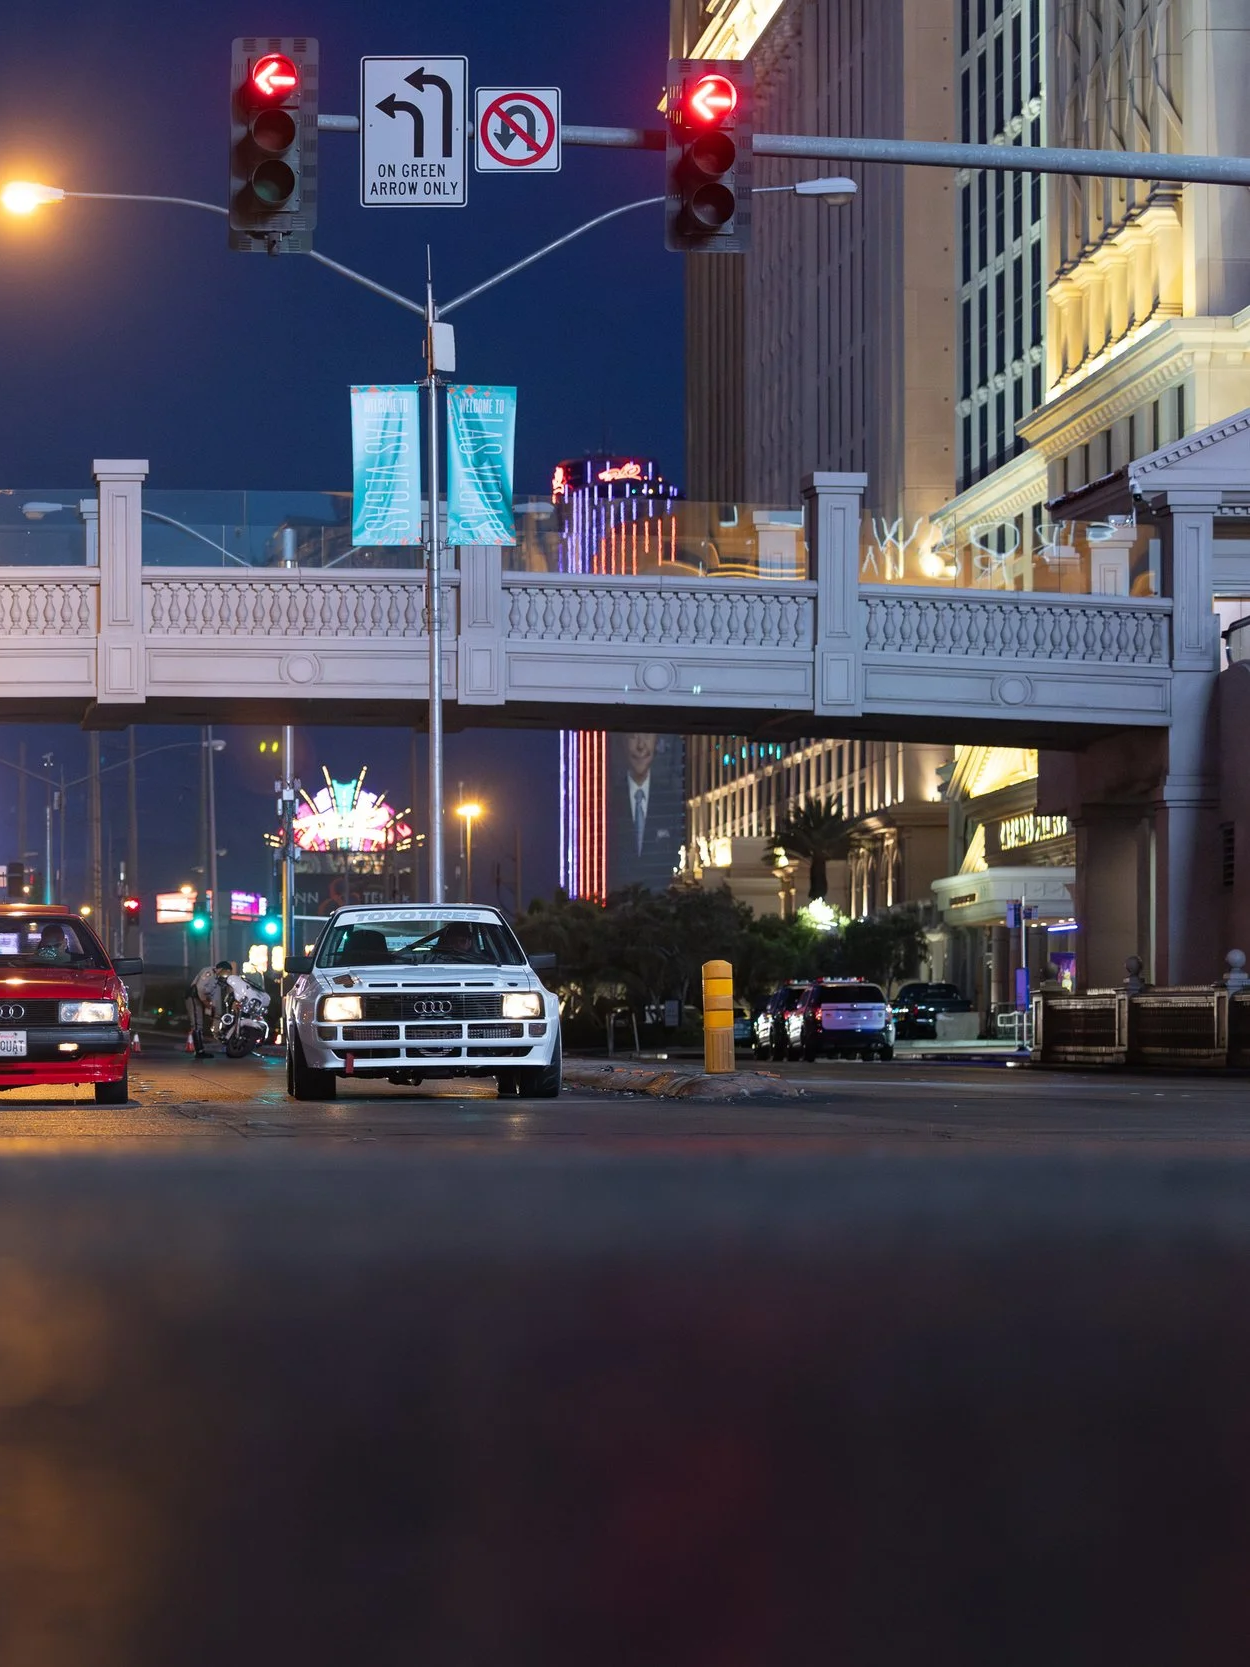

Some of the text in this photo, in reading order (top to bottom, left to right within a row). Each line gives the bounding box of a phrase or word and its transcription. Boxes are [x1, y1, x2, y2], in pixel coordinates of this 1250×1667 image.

[378, 163, 446, 178] ON GREEN
[370, 181, 458, 196] ARROW ONLY
[364, 398, 409, 413] WELCOME TO
[459, 398, 505, 414] WELCOME TO
[364, 417, 410, 532] LAS VEGAS
[458, 419, 504, 532] LAS VEGAS
[355, 911, 481, 922] TOYO TIRES
